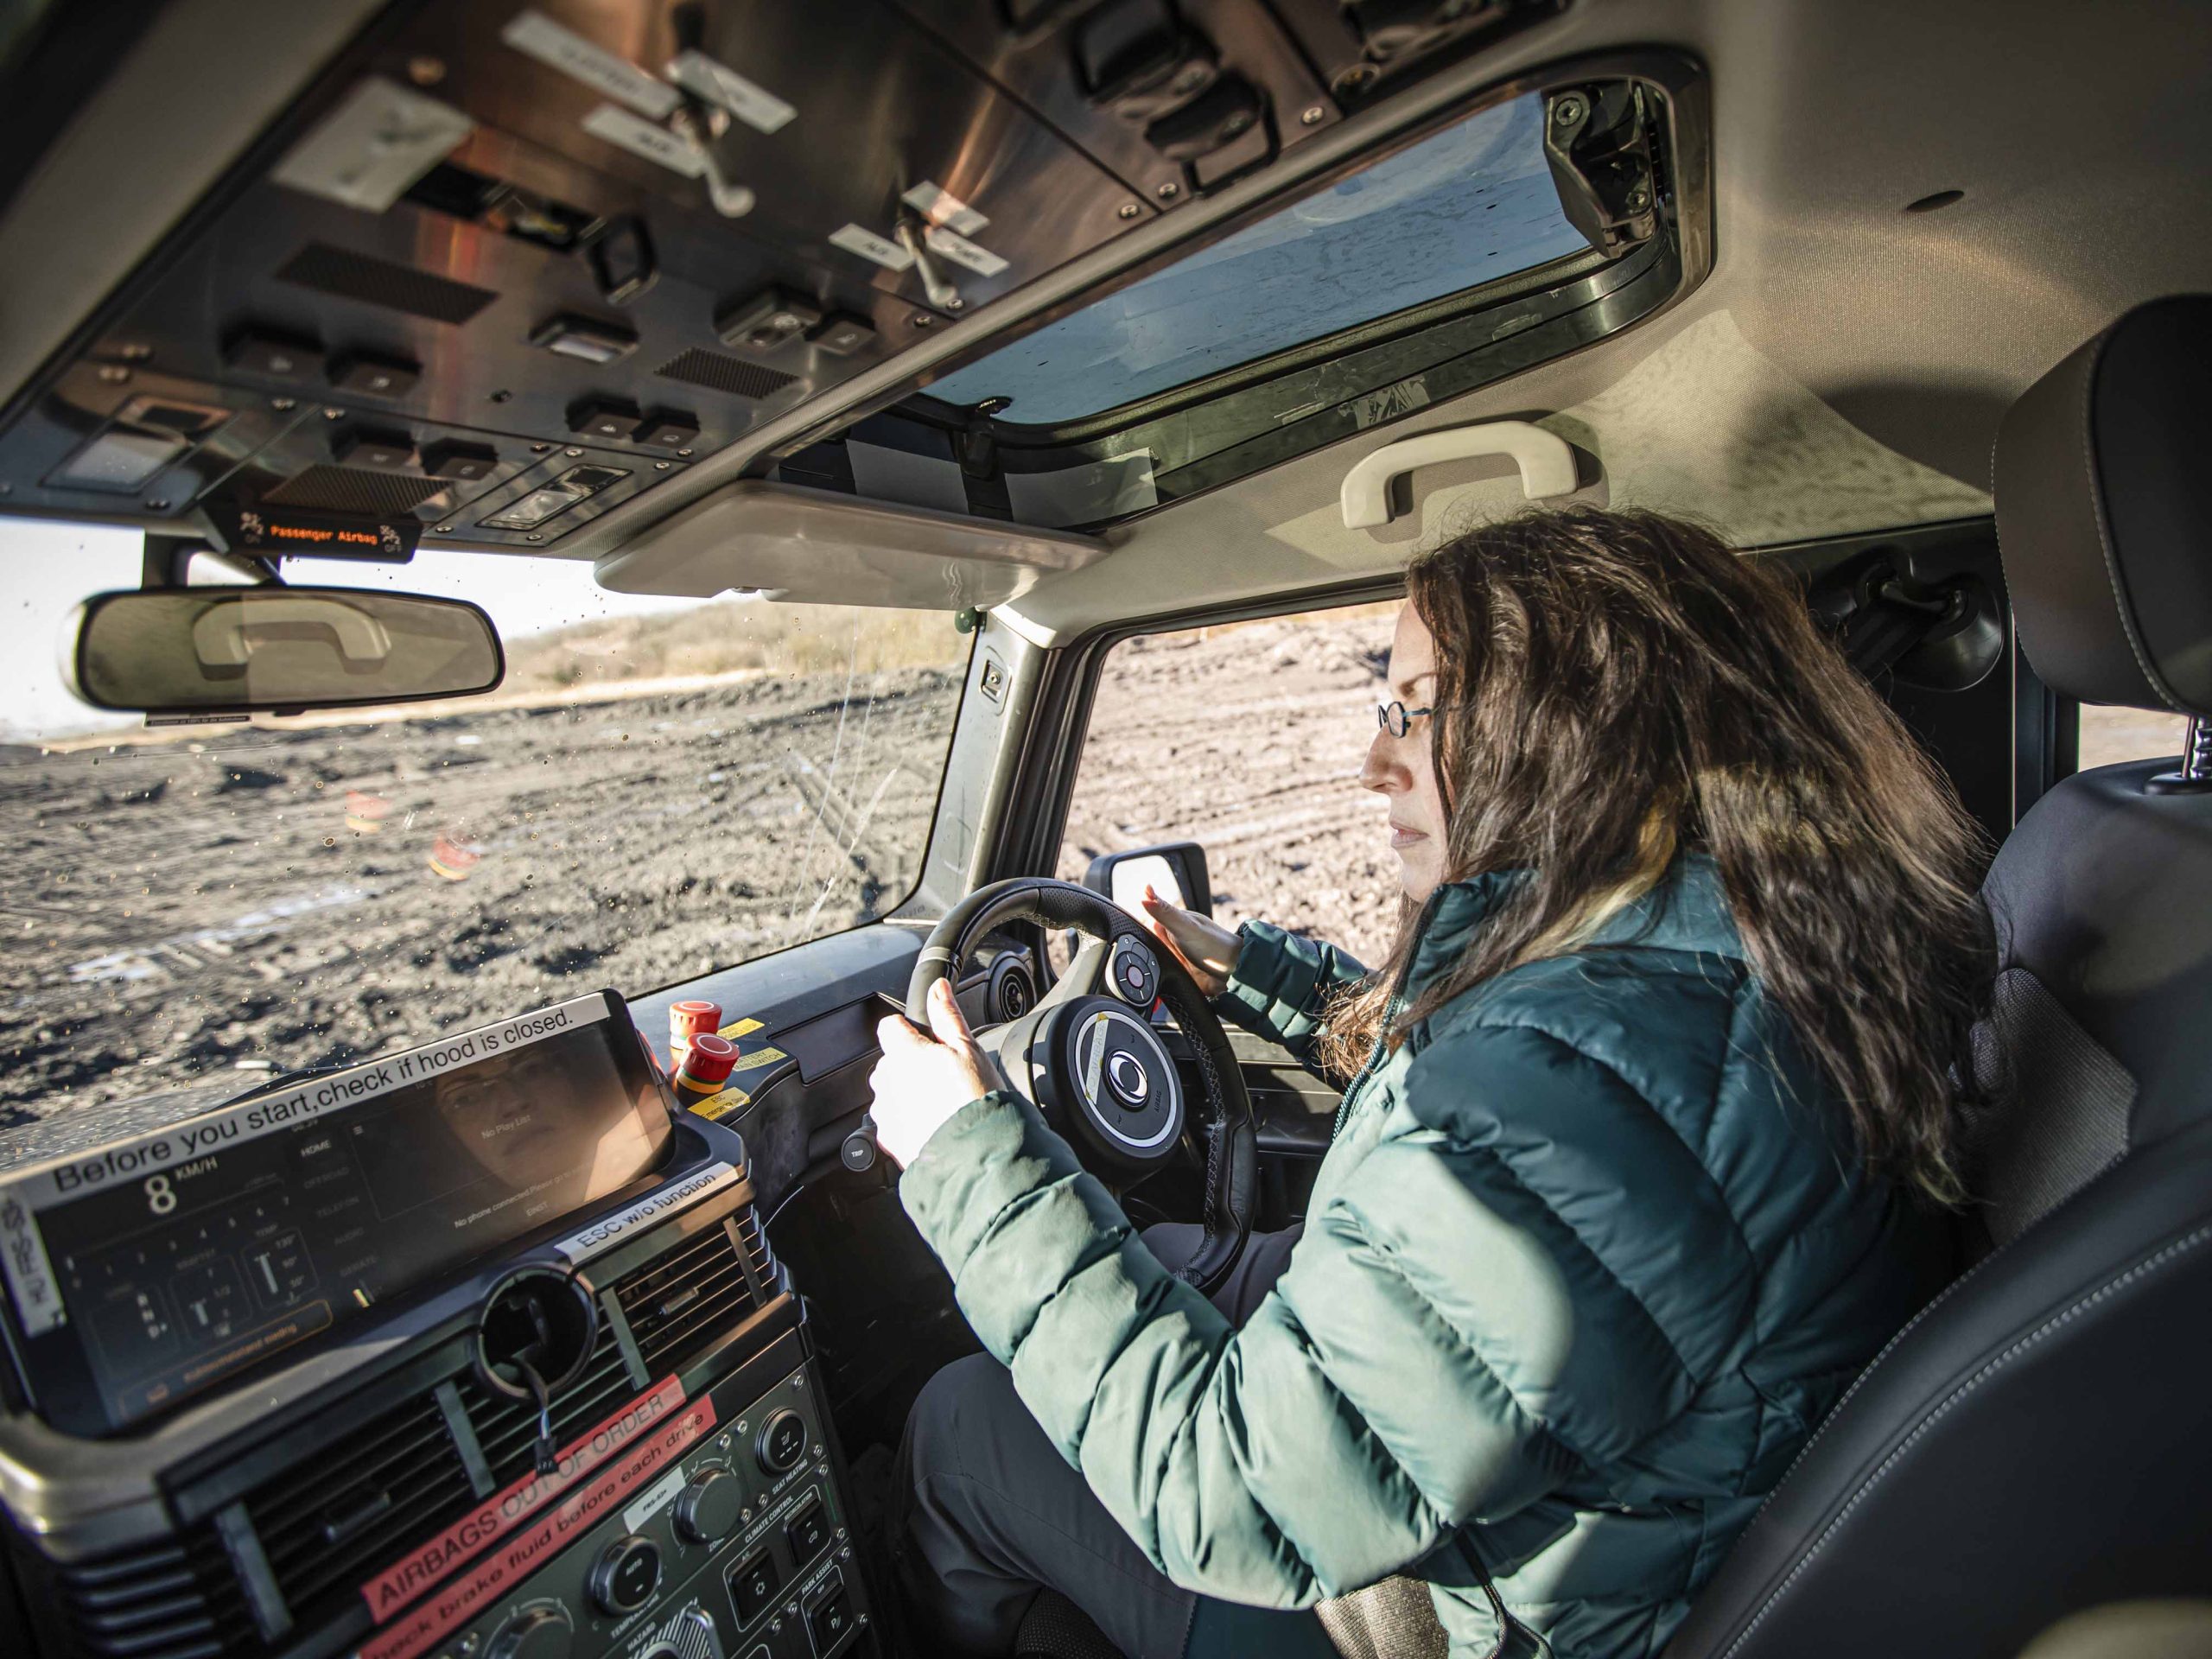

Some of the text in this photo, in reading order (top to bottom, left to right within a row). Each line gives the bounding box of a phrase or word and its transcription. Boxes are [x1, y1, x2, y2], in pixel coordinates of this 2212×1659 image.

[270, 525, 378, 545] Passenger Airbag
[53, 1141, 172, 1192] Before
[180, 1118, 239, 1155] you
[397, 1053, 416, 1080] if
[417, 1039, 476, 1073] hood
[481, 1033, 499, 1052] is
[504, 1008, 574, 1045] closed.
[481, 1115, 531, 1140] No Play List
[301, 1139, 331, 1157] HOME
[143, 1174, 177, 1214] 8
[175, 1156, 218, 1182] KM/H
[454, 1217, 467, 1229] No
[467, 1207, 492, 1224] phone
[576, 1173, 716, 1248] ESC w/o function
[772, 1459, 808, 1495] SEAT HEATING
[378, 1394, 664, 1608] AIRBAGS OUT OF ORDER
[439, 1568, 504, 1620] brake
[508, 1529, 552, 1569] fluid
[557, 1482, 616, 1532] before
[620, 1446, 662, 1484] each
[665, 1414, 703, 1448] drive
[745, 1495, 793, 1543] CLIMATE CONTROL
[801, 1559, 834, 1595] PARK ASSIST
[627, 1622, 656, 1653] HAZARD
